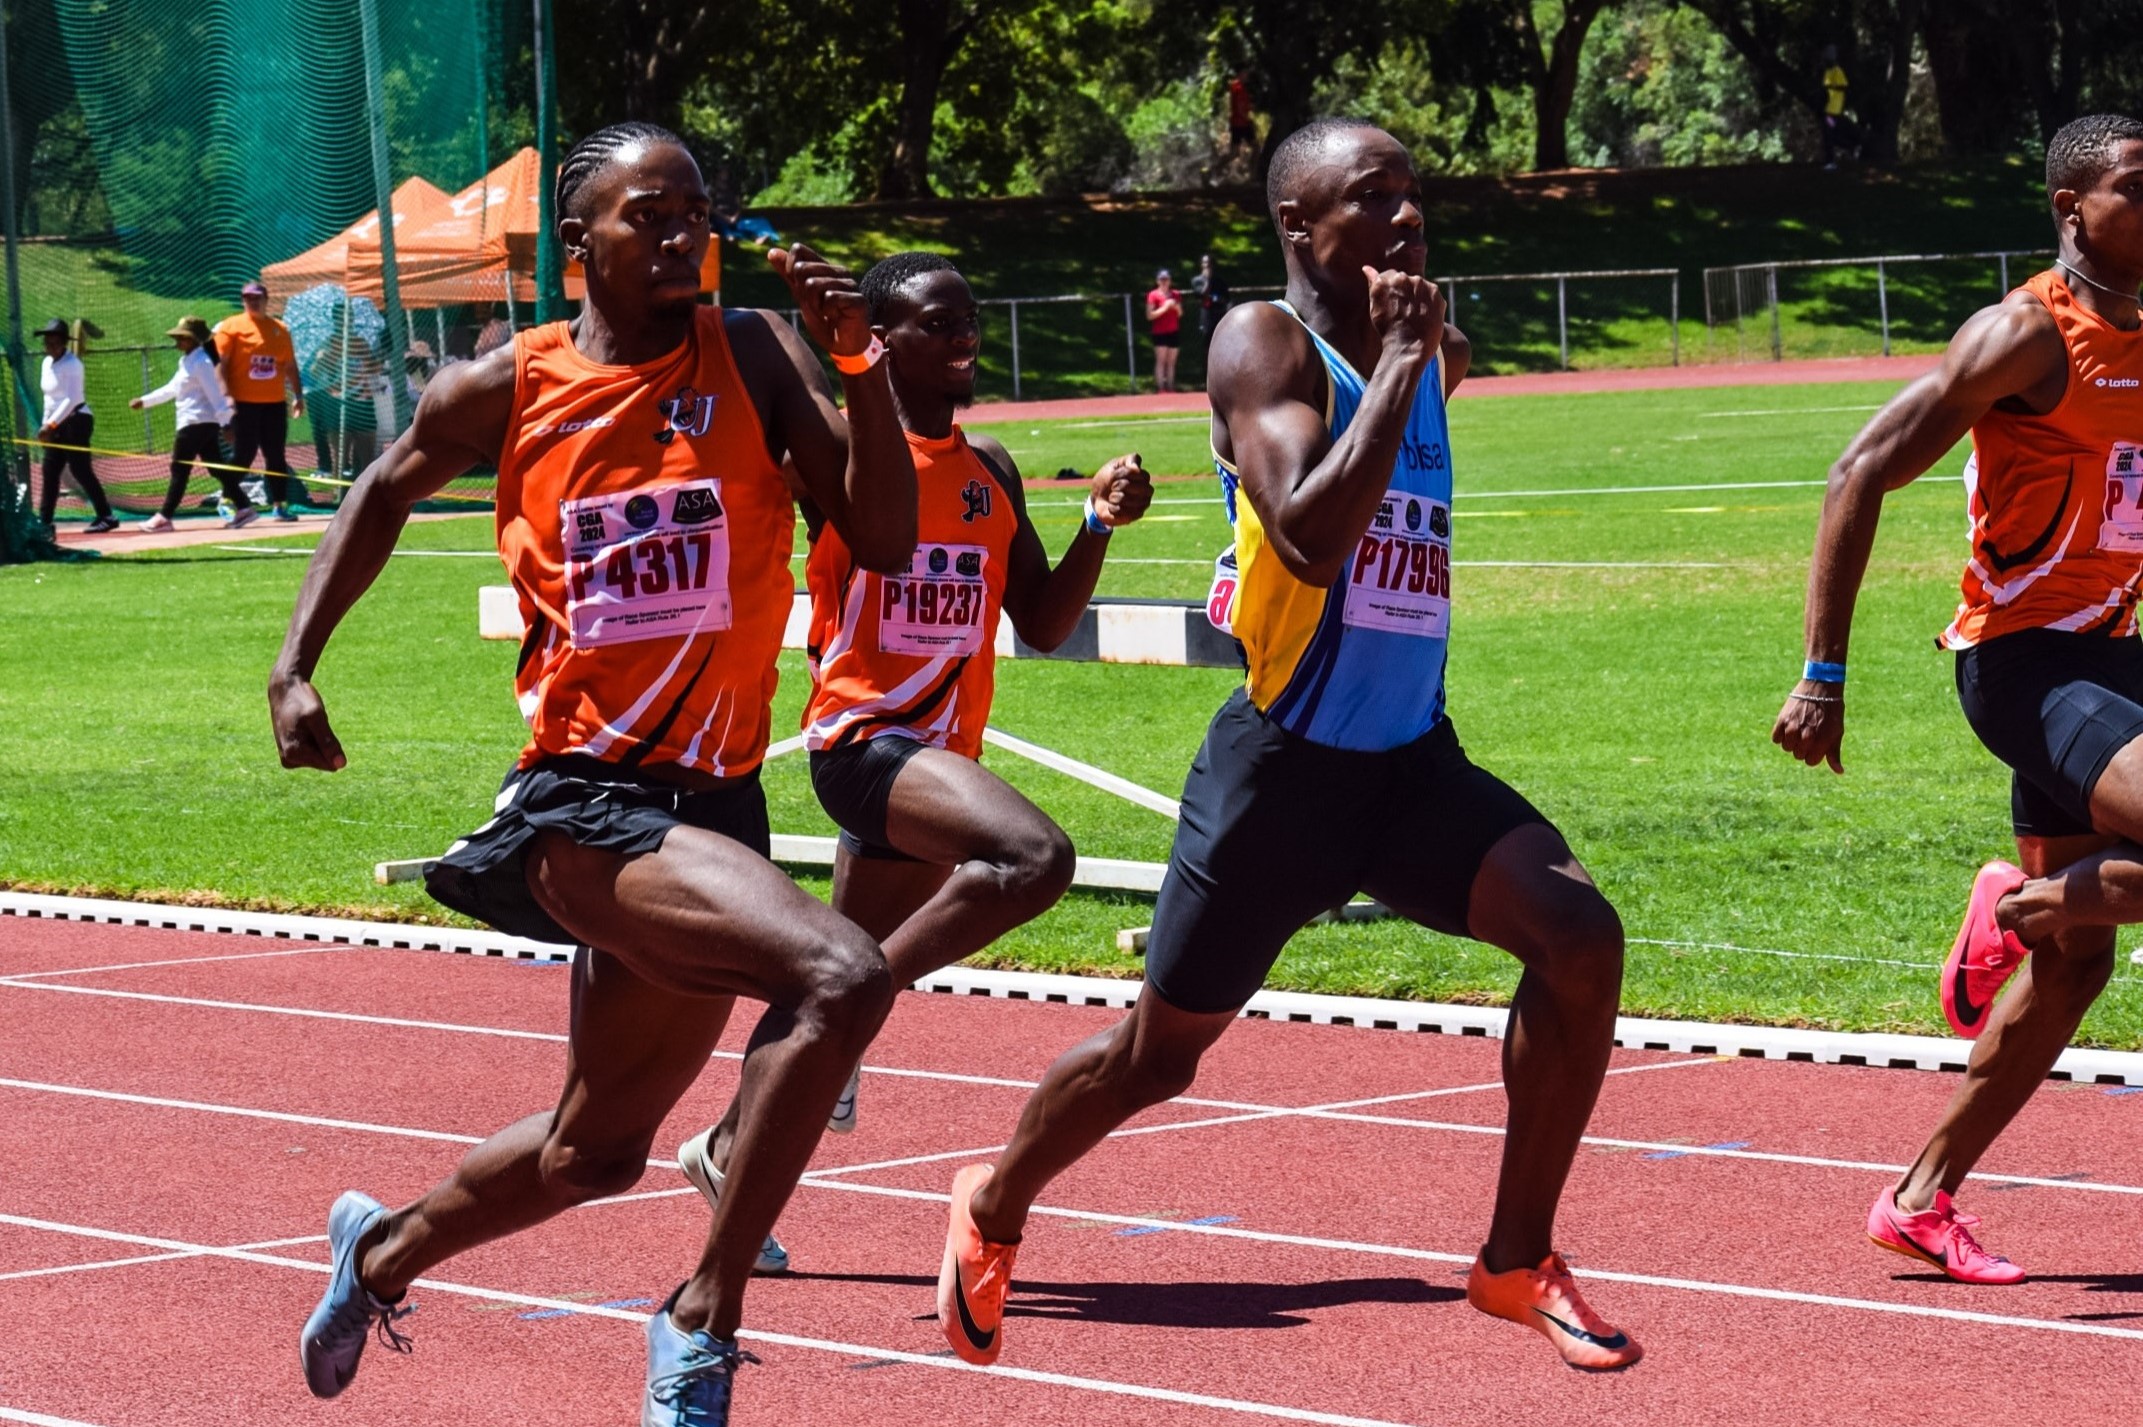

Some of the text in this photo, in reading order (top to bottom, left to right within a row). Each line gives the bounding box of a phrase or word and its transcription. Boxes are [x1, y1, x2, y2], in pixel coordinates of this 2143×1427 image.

[2109, 379, 2139, 388] lotto
[558, 416, 615, 433] lotto
[669, 395, 719, 437] UJ
[1398, 434, 1444, 470] bisa
[2116, 461, 2131, 472] 2024
[679, 491, 715, 511] ASA
[577, 511, 604, 527] CGA
[1375, 514, 1392, 529] 2024
[579, 525, 606, 542] 2024
[958, 555, 978, 567] ASA
[1353, 535, 1450, 599] P17996
[883, 580, 982, 626] P19237
[1210, 579, 1236, 625] a
